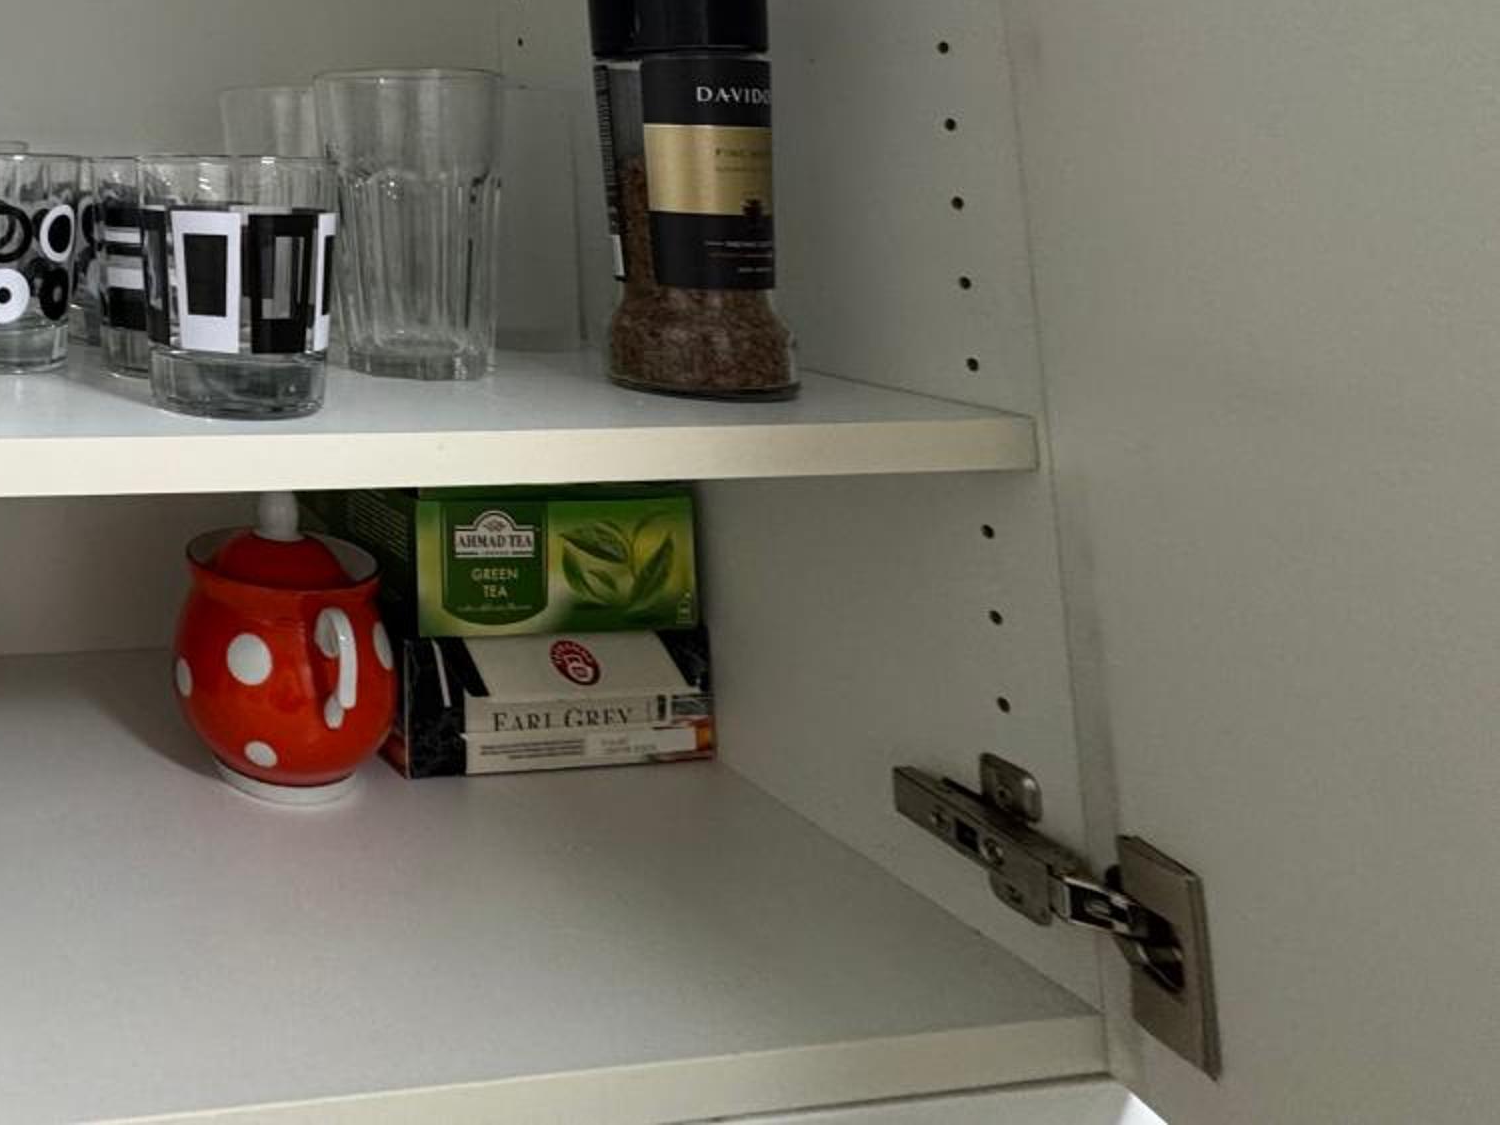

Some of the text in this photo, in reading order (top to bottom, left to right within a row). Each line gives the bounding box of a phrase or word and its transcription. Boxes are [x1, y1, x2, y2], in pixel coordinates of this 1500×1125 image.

[457, 534, 534, 548] AHMAD TEA
[470, 567, 518, 582] GREEN
[483, 584, 509, 599] TEA
[492, 706, 633, 733] EARL GREY
